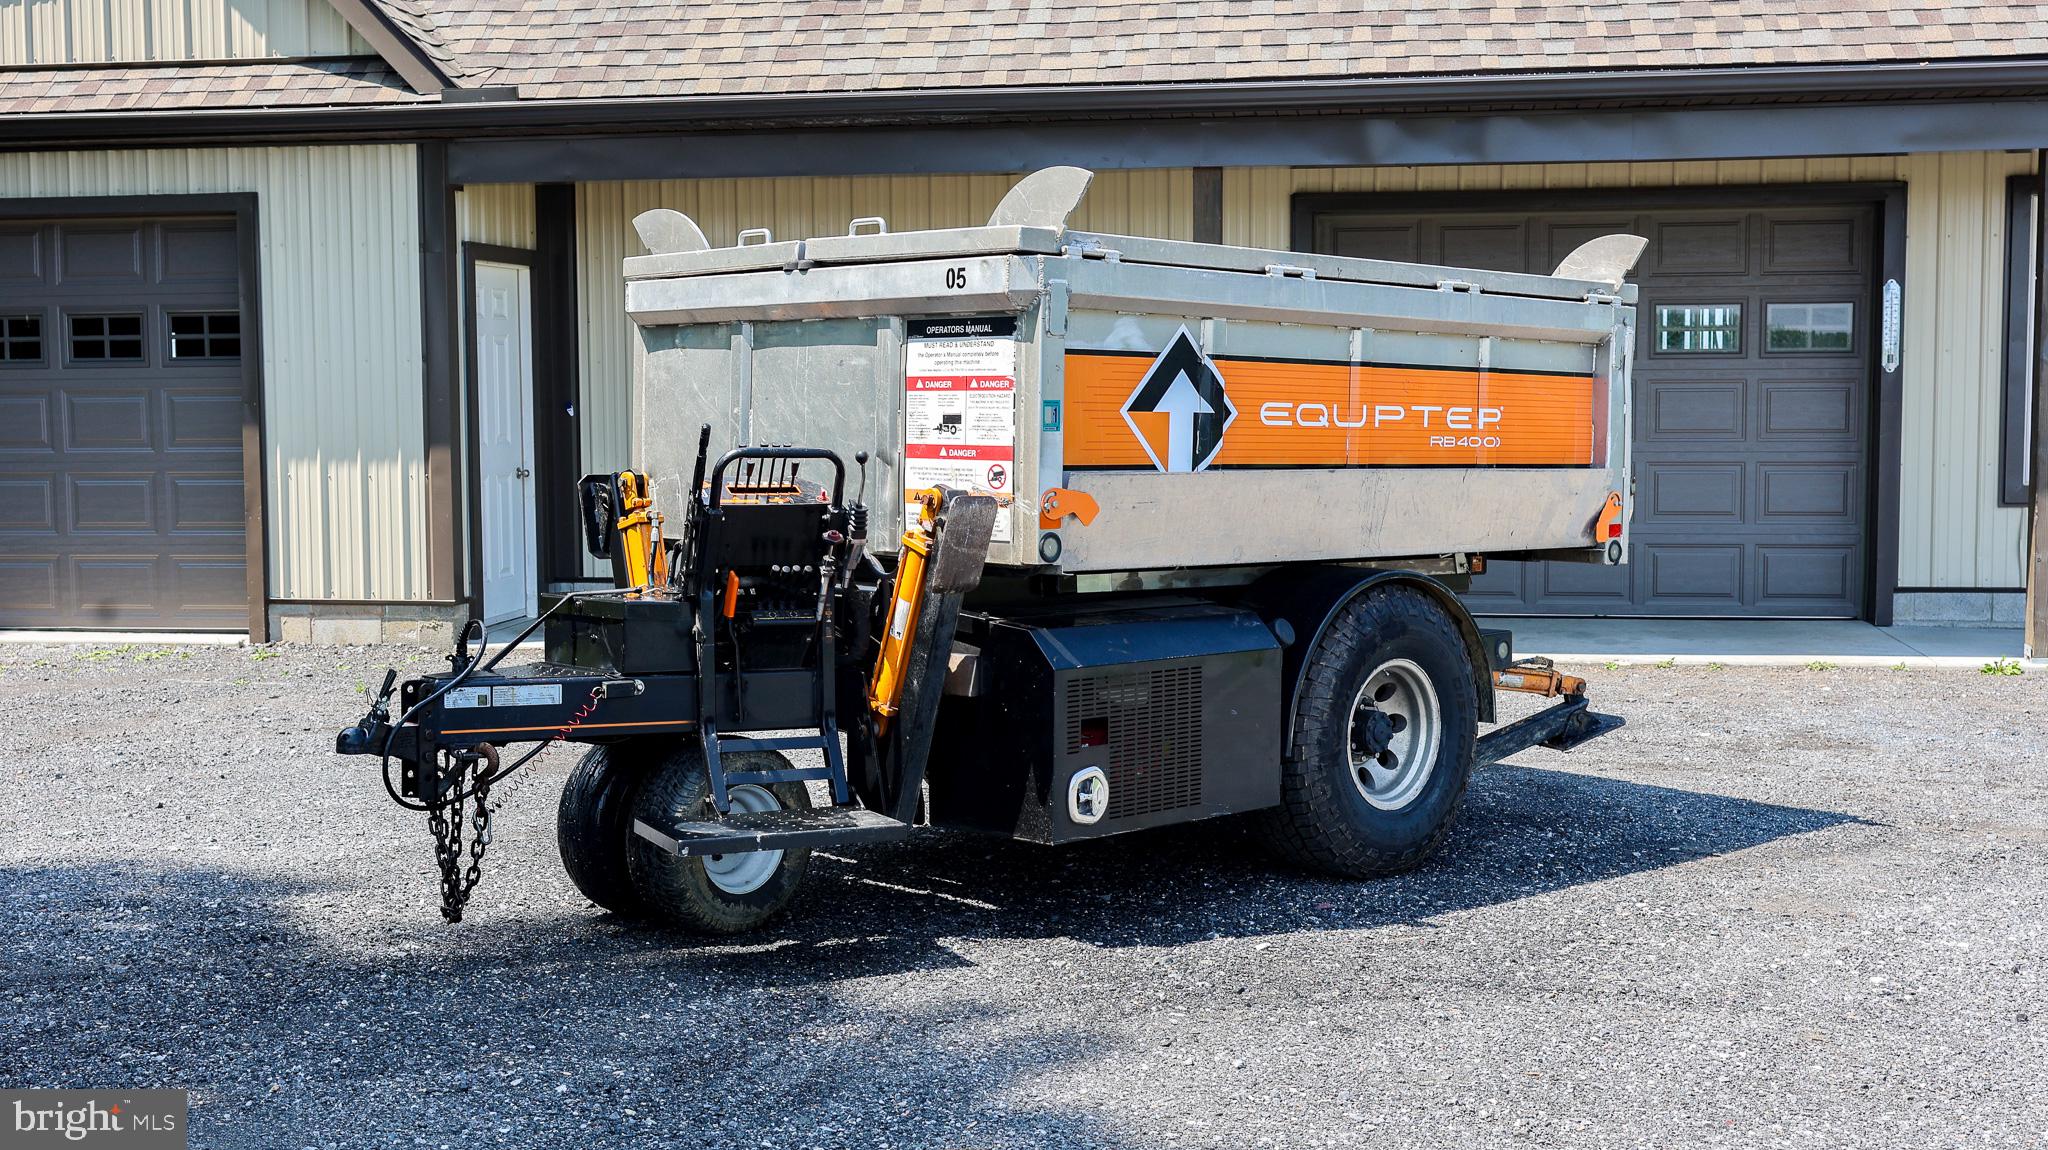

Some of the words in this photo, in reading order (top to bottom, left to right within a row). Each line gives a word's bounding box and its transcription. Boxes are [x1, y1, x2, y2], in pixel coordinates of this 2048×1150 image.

[946, 267, 967, 289] 05
[926, 325, 965, 334] OPERATORS
[965, 324, 993, 334] MANUAL
[959, 340, 995, 348] UNDERSTAND
[925, 380, 952, 388] DANGER
[980, 380, 1010, 388] DANGER
[949, 449, 976, 457] DANGER
